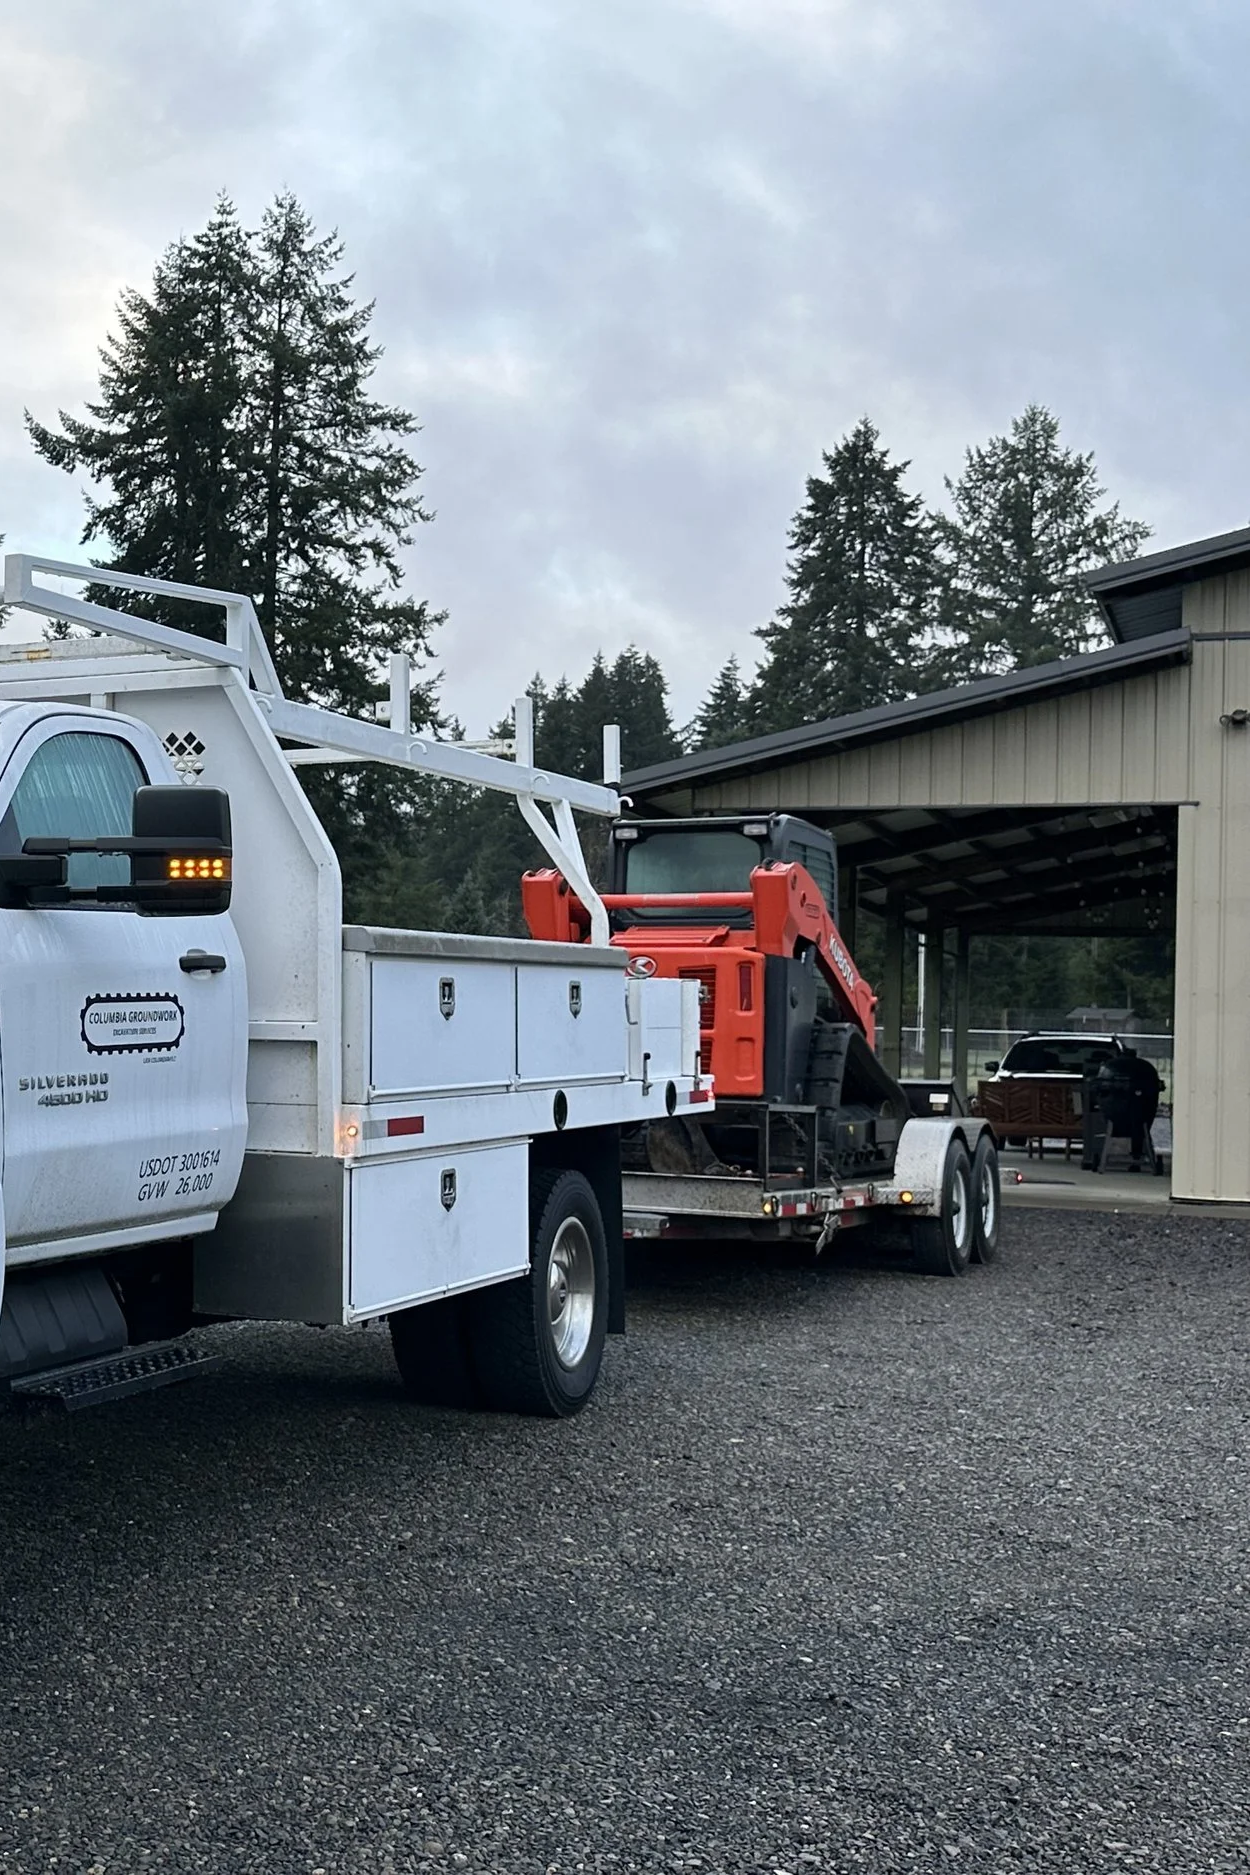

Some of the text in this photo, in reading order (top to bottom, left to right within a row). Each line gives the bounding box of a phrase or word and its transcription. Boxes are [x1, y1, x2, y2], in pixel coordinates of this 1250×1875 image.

[830, 934, 853, 990] KUBOTA
[89, 1010, 178, 1025] COLUMBIA GROUNDWORK
[19, 1072, 109, 1091] SILVERADO
[85, 1089, 109, 1104] HD
[139, 1148, 221, 1179] USDOT 3001614
[137, 1172, 214, 1201] GVW 26,000
